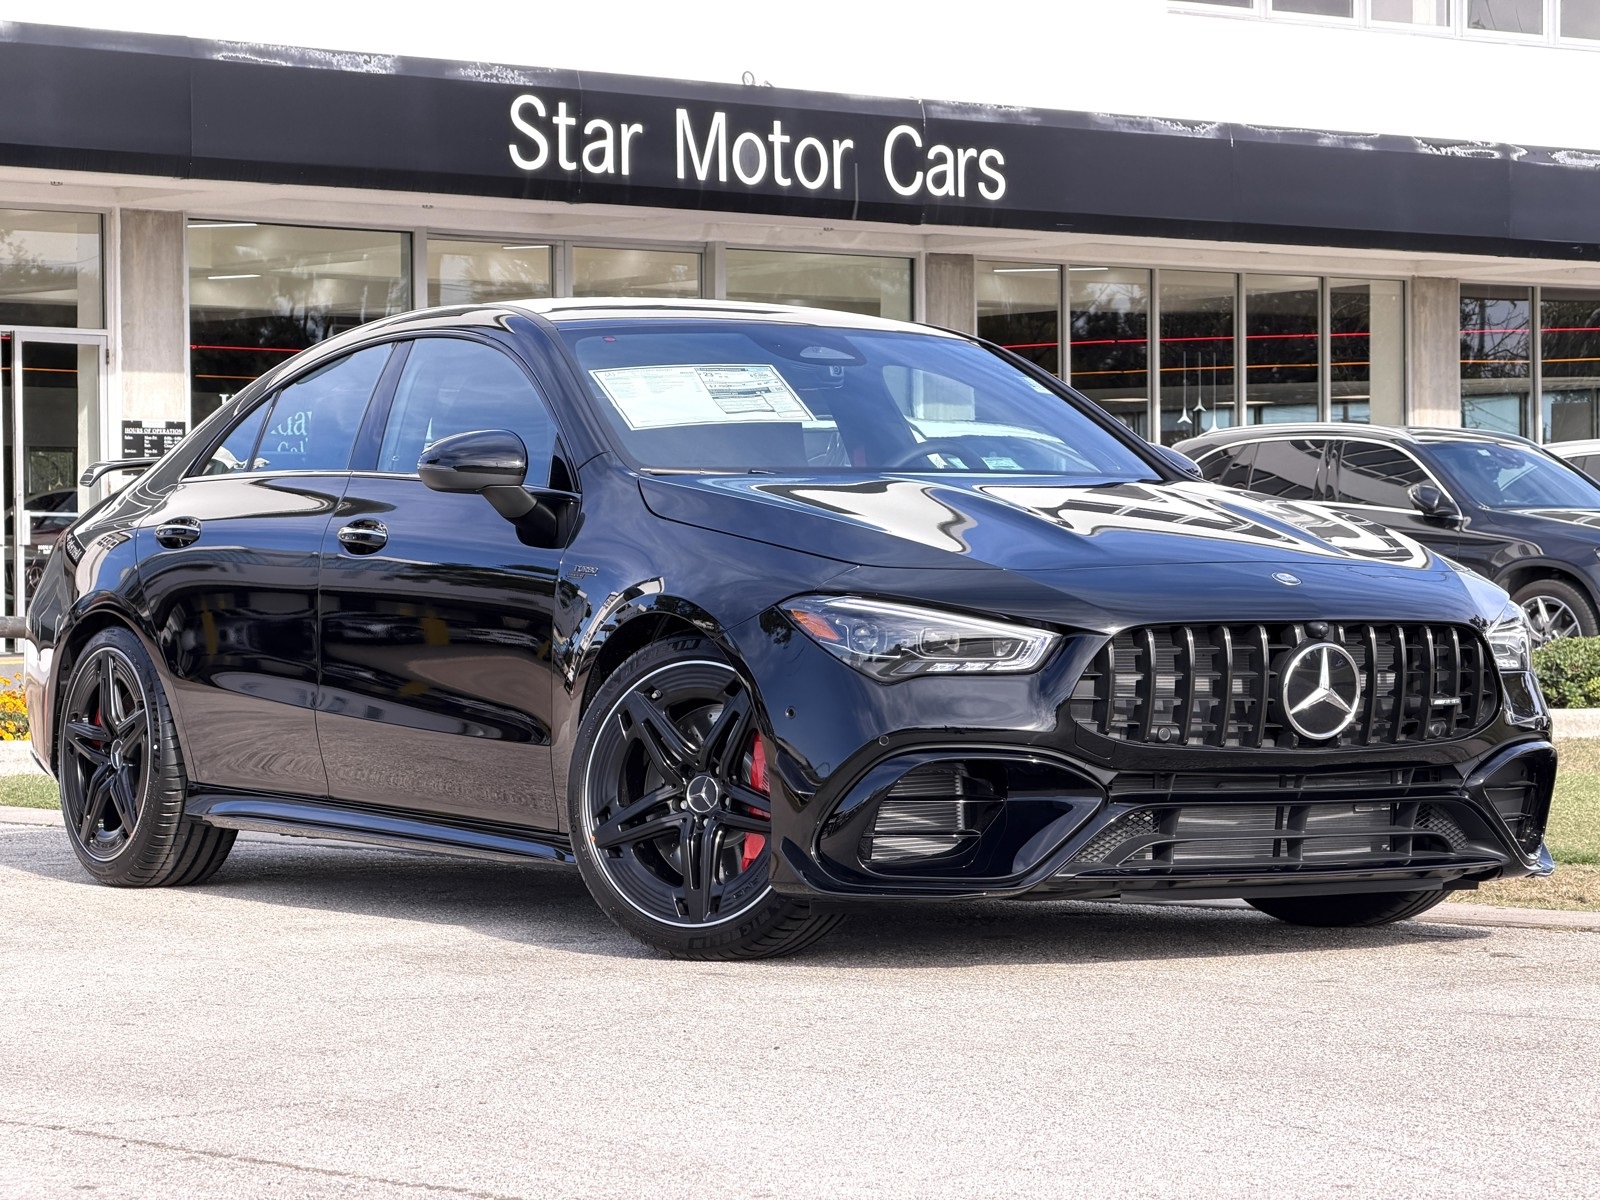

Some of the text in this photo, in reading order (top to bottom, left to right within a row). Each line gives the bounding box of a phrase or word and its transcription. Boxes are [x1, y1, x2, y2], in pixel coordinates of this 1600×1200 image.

[509, 94, 1006, 200] Star Motor Cars
